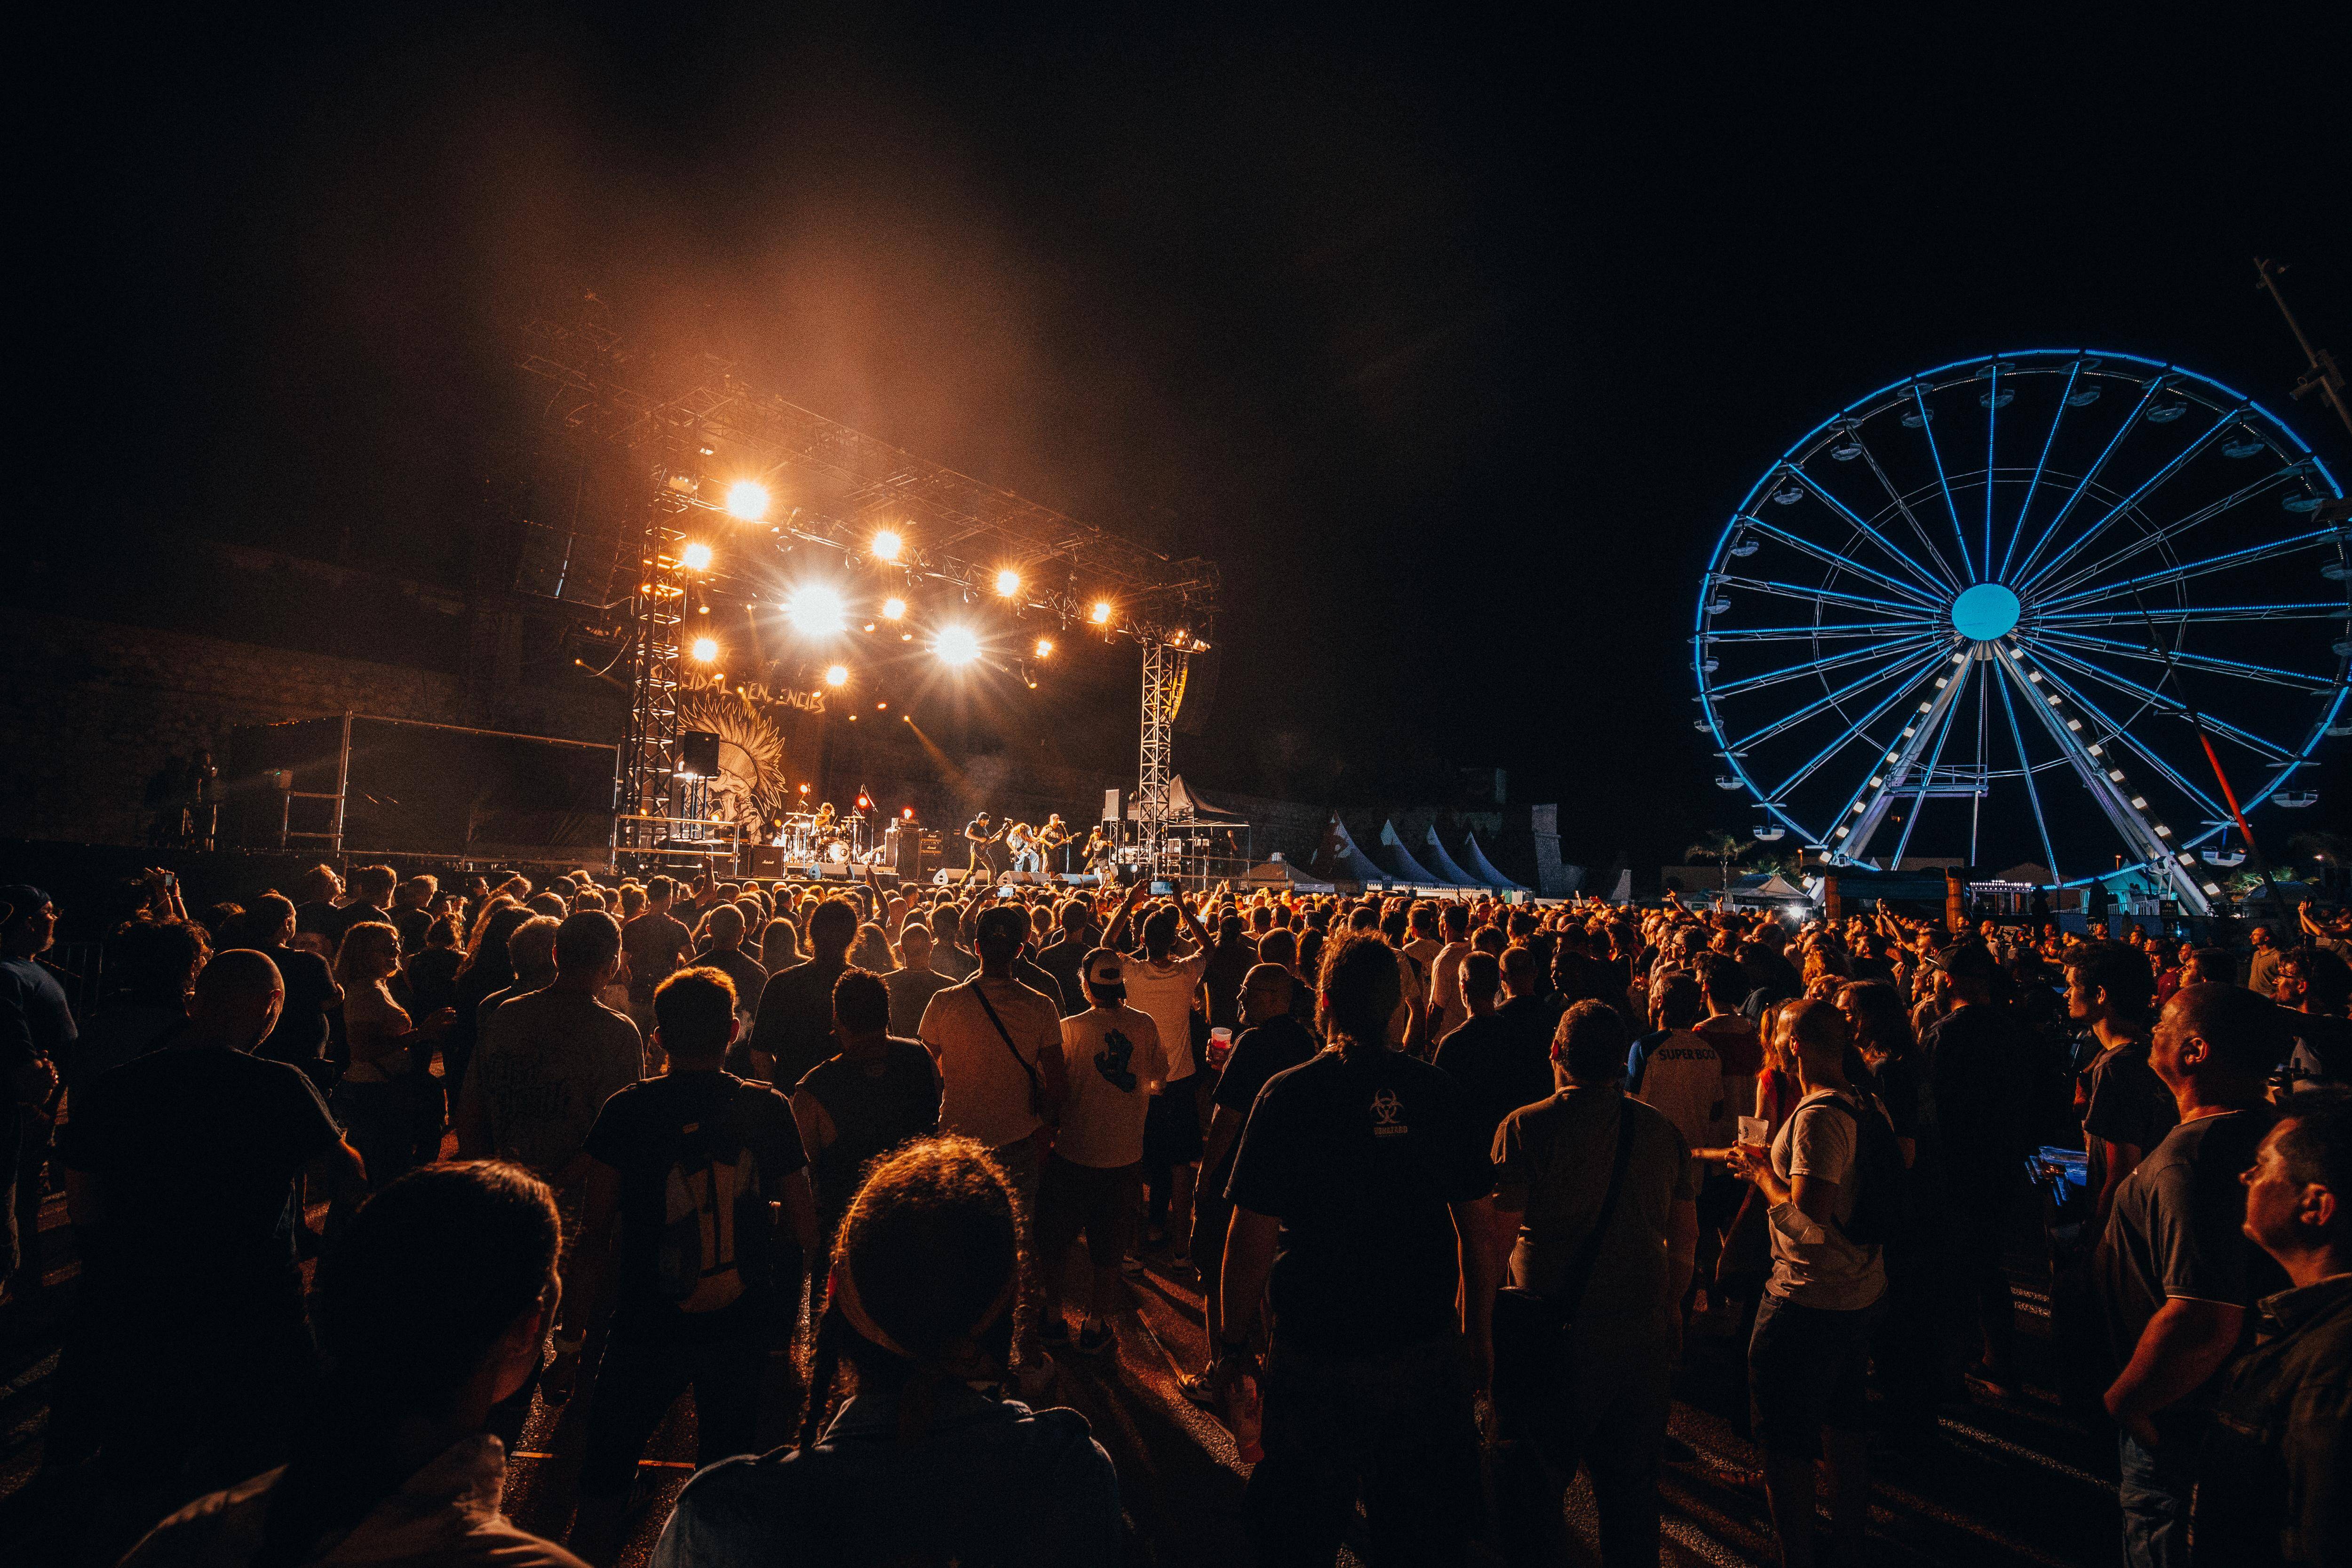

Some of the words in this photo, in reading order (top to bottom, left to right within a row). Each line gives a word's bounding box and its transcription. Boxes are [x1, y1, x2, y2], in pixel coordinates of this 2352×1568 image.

[650, 663, 733, 695] SIDAL
[740, 681, 827, 713] ENNCIES
[1659, 1049, 1694, 1060] SUPER
